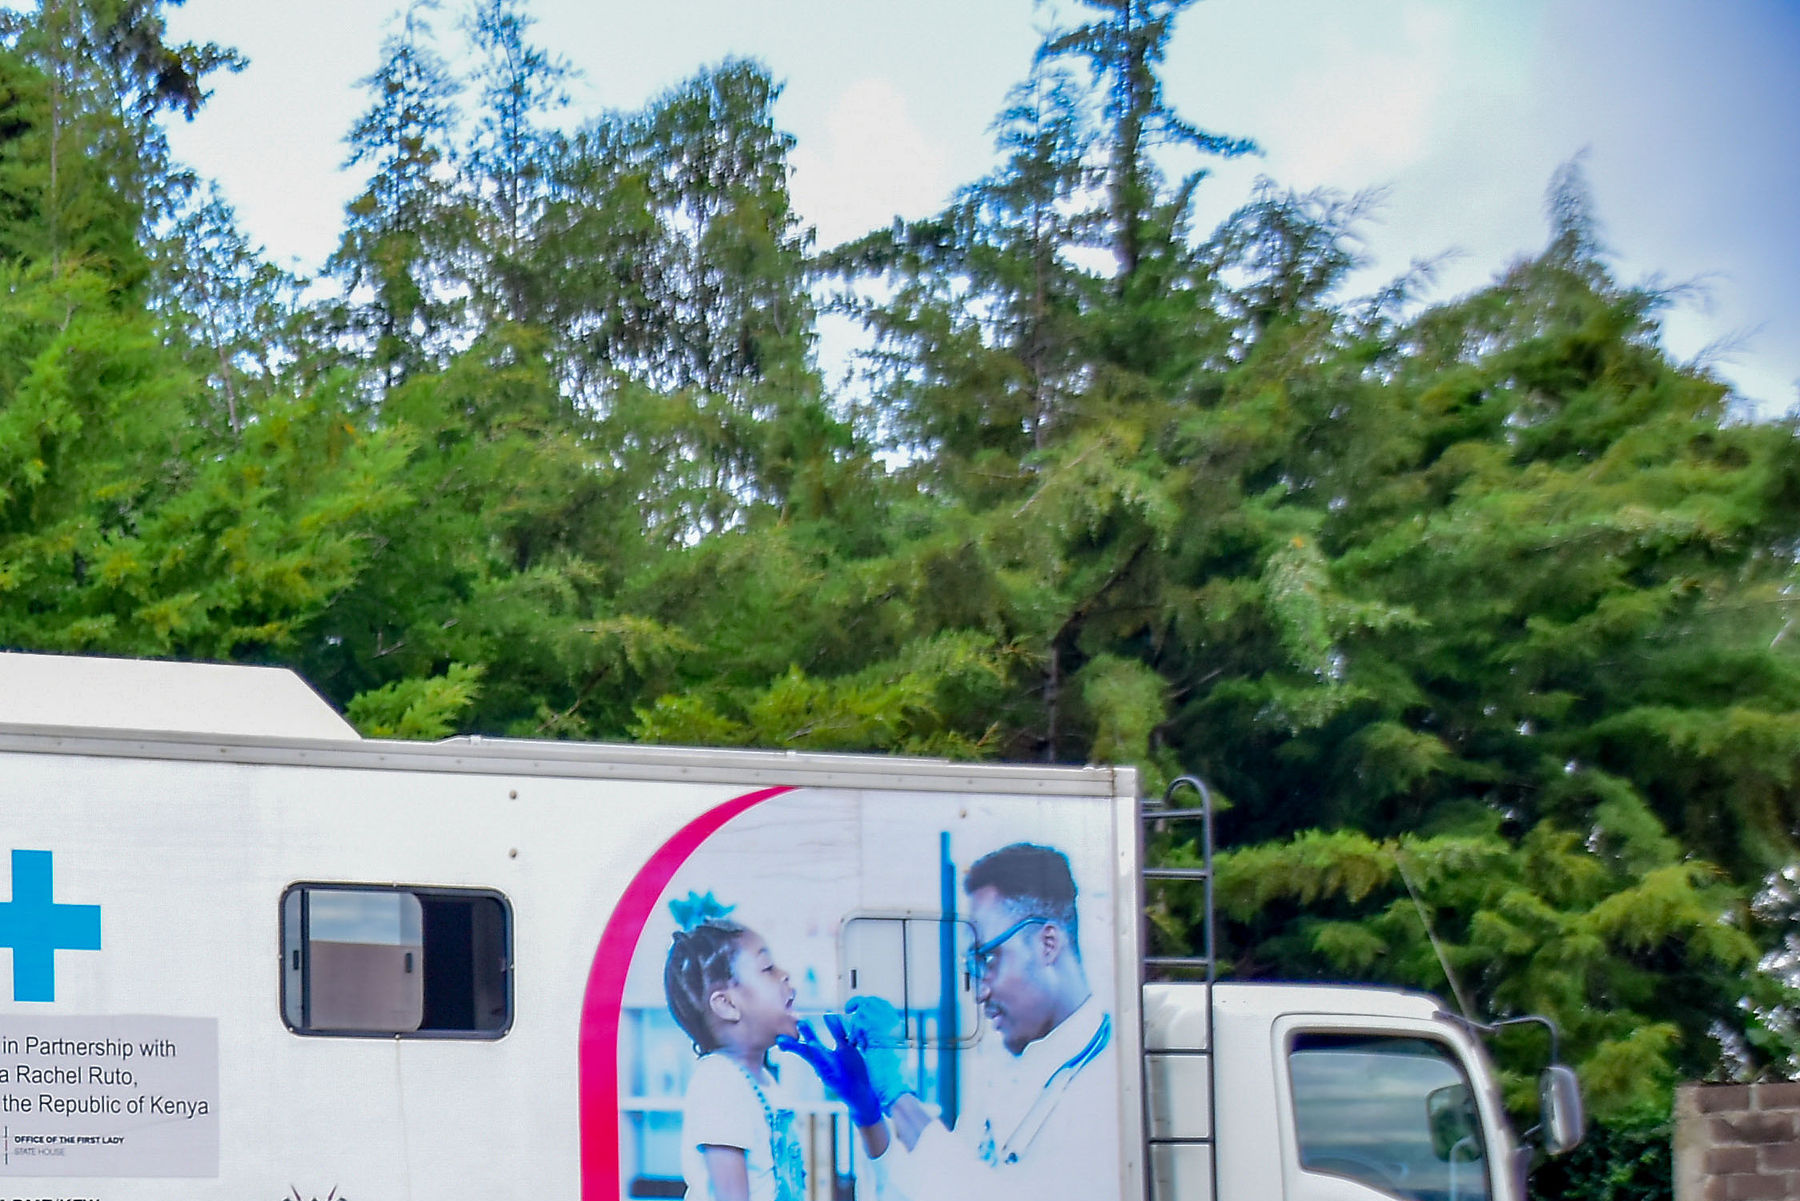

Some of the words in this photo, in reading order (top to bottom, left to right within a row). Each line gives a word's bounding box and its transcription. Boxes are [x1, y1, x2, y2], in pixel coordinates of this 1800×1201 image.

[3, 1036, 18, 1054] in
[26, 1037, 133, 1060] Partnership
[140, 1040, 175, 1057] with
[17, 1065, 81, 1084] Rachel
[90, 1067, 137, 1087] Ruto,
[3, 1094, 31, 1112] the
[40, 1095, 120, 1117] Republic
[127, 1095, 145, 1113] of
[151, 1096, 208, 1119] Kenya
[14, 1136, 45, 1144] OFFICE
[101, 1137, 125, 1145] LADY
[37, 1148, 65, 1156] HOUSE
